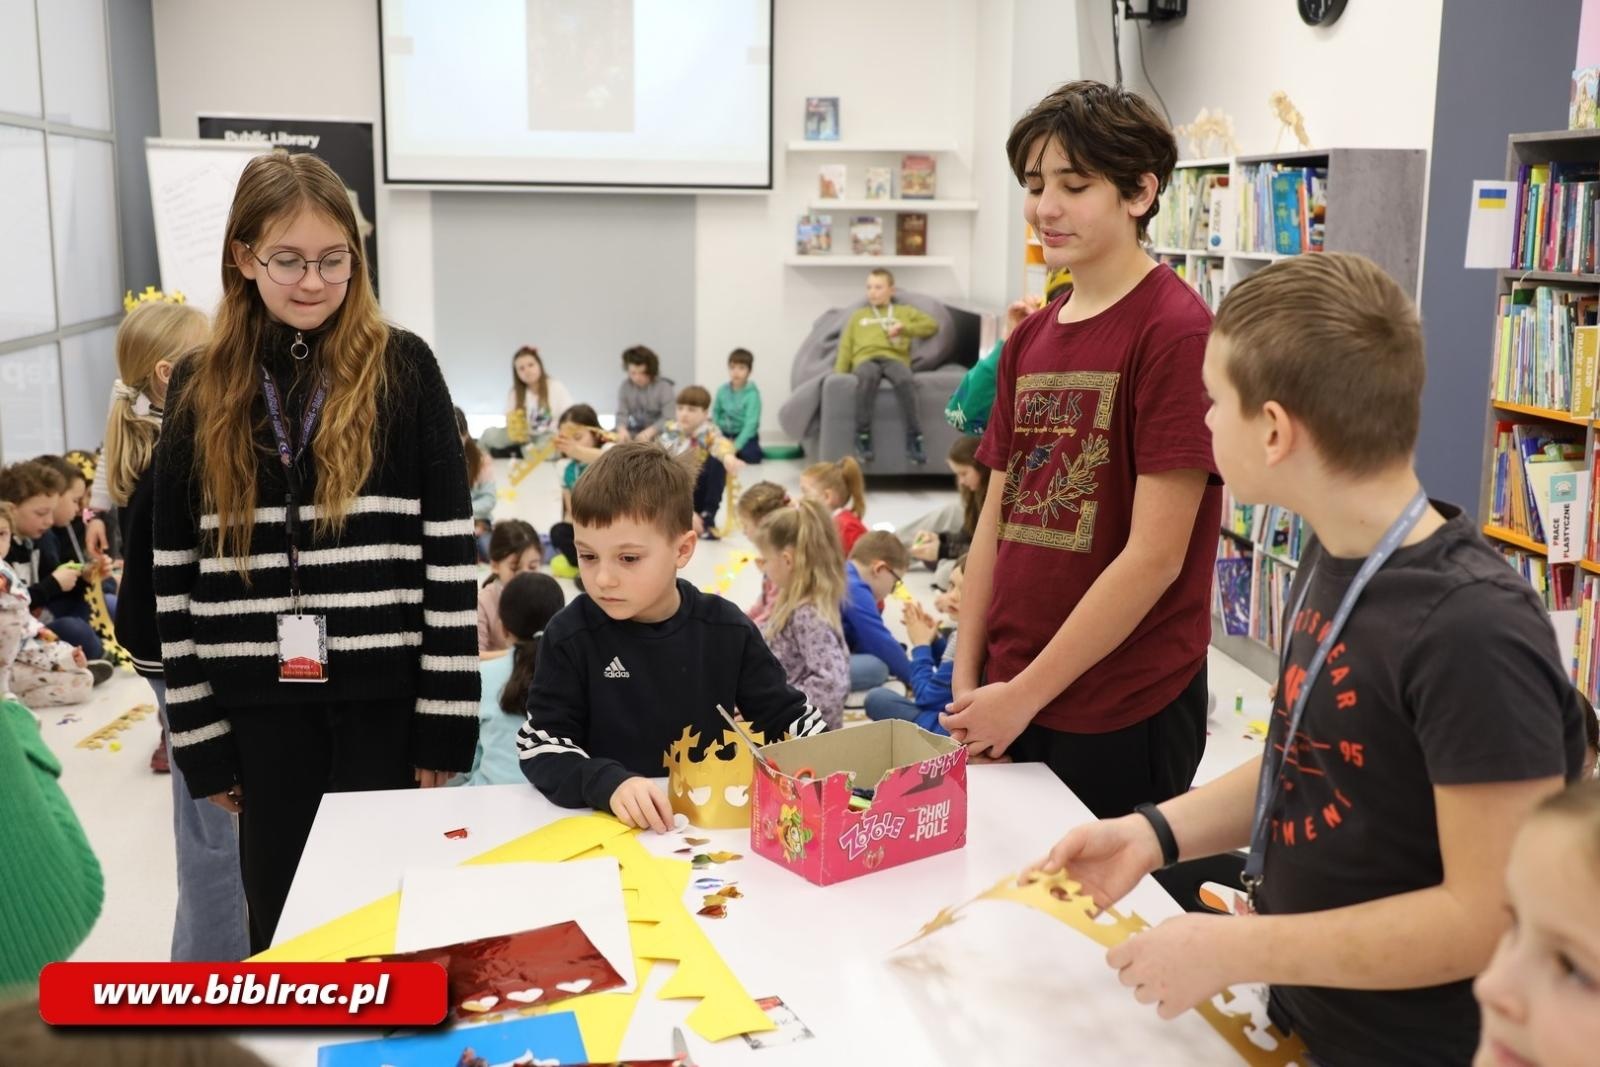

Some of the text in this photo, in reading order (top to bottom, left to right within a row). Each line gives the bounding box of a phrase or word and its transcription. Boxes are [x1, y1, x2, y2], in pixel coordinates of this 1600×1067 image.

[224, 130, 320, 149] Public Library
[1552, 517, 1560, 546] PRACE
[1563, 503, 1571, 559] PLASTYCZNE
[603, 670, 630, 678] adidas
[1338, 740, 1364, 768] 95
[917, 799, 951, 825] CHRU
